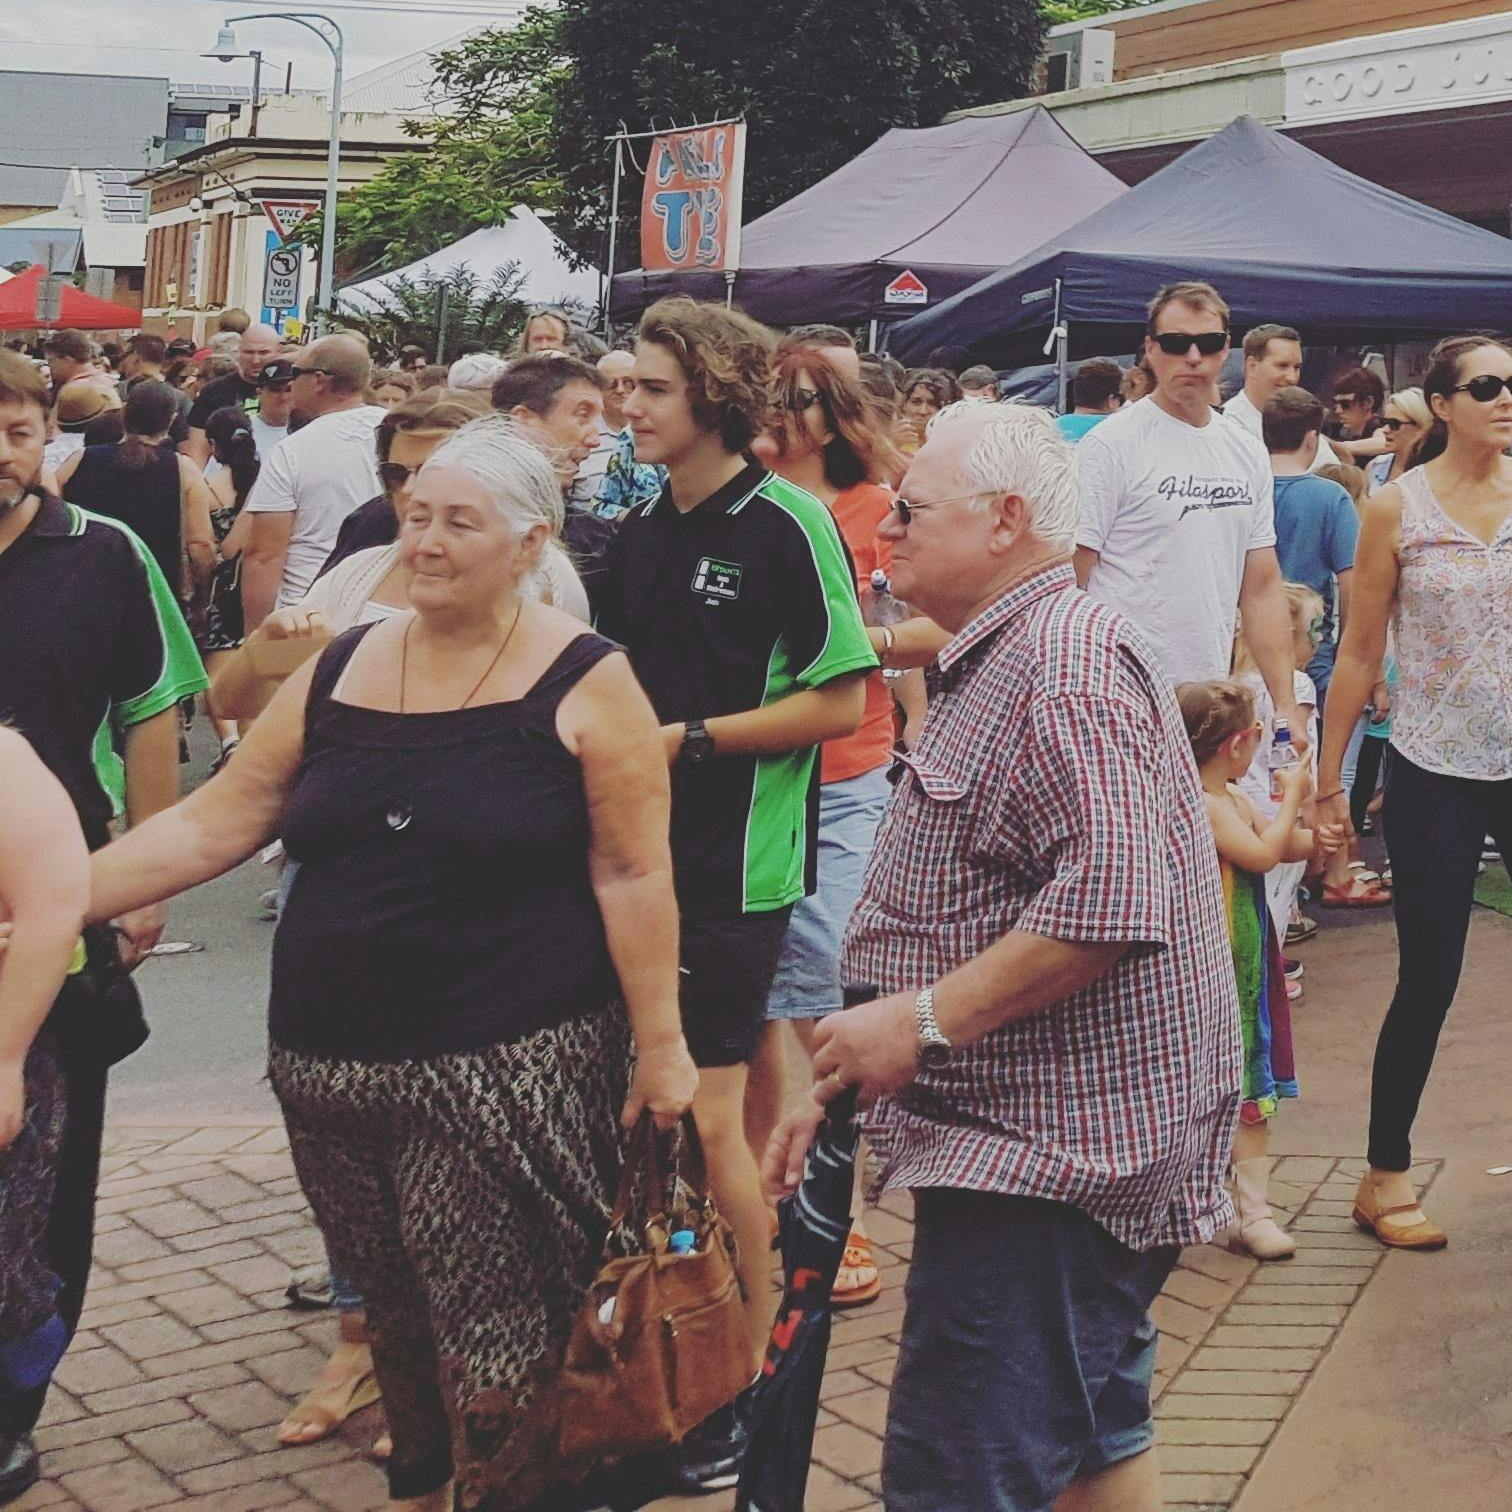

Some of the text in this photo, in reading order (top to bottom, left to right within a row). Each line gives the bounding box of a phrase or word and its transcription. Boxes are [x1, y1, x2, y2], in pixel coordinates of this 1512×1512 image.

[1304, 64, 1416, 106] GOOD
[276, 209, 302, 218] GIVE
[273, 278, 291, 287] NO
[270, 289, 293, 297] LEFT
[269, 297, 293, 305] TURN
